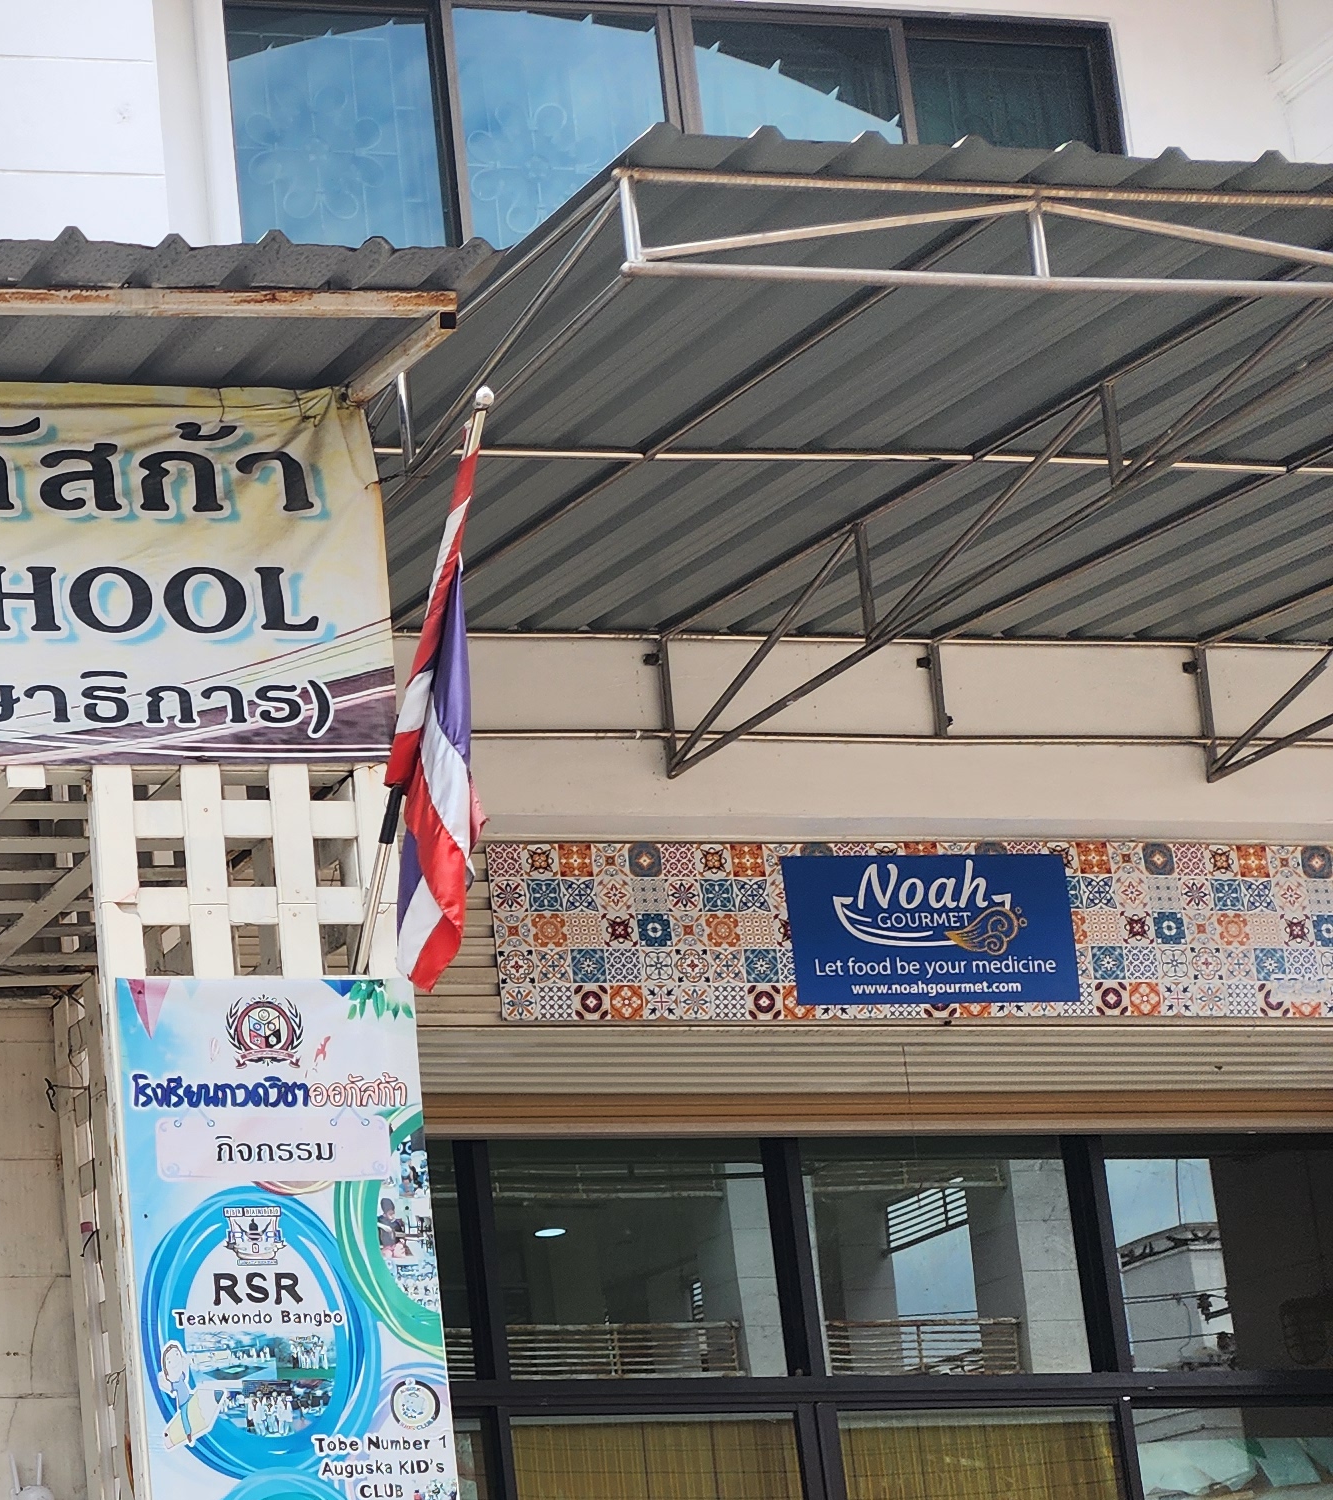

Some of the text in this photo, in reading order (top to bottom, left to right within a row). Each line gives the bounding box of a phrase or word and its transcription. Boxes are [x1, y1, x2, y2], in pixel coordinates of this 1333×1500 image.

[857, 860, 989, 909] Noah
[877, 911, 971, 928] GOURMET
[815, 955, 1057, 979] Let food be your medicine
[851, 980, 1022, 997] www.noahgourmet.com
[132, 1072, 407, 1108] โรงเรียนกวดวิชาออกัสก้า
[214, 1135, 335, 1163] กิจกรรม
[212, 1272, 304, 1307] RSR
[175, 1309, 344, 1327] Teakwondo Bangbo
[314, 1435, 448, 1453] Tobe Number 1
[321, 1459, 445, 1478] Auguska KID's
[360, 1483, 404, 1499] CLUB
